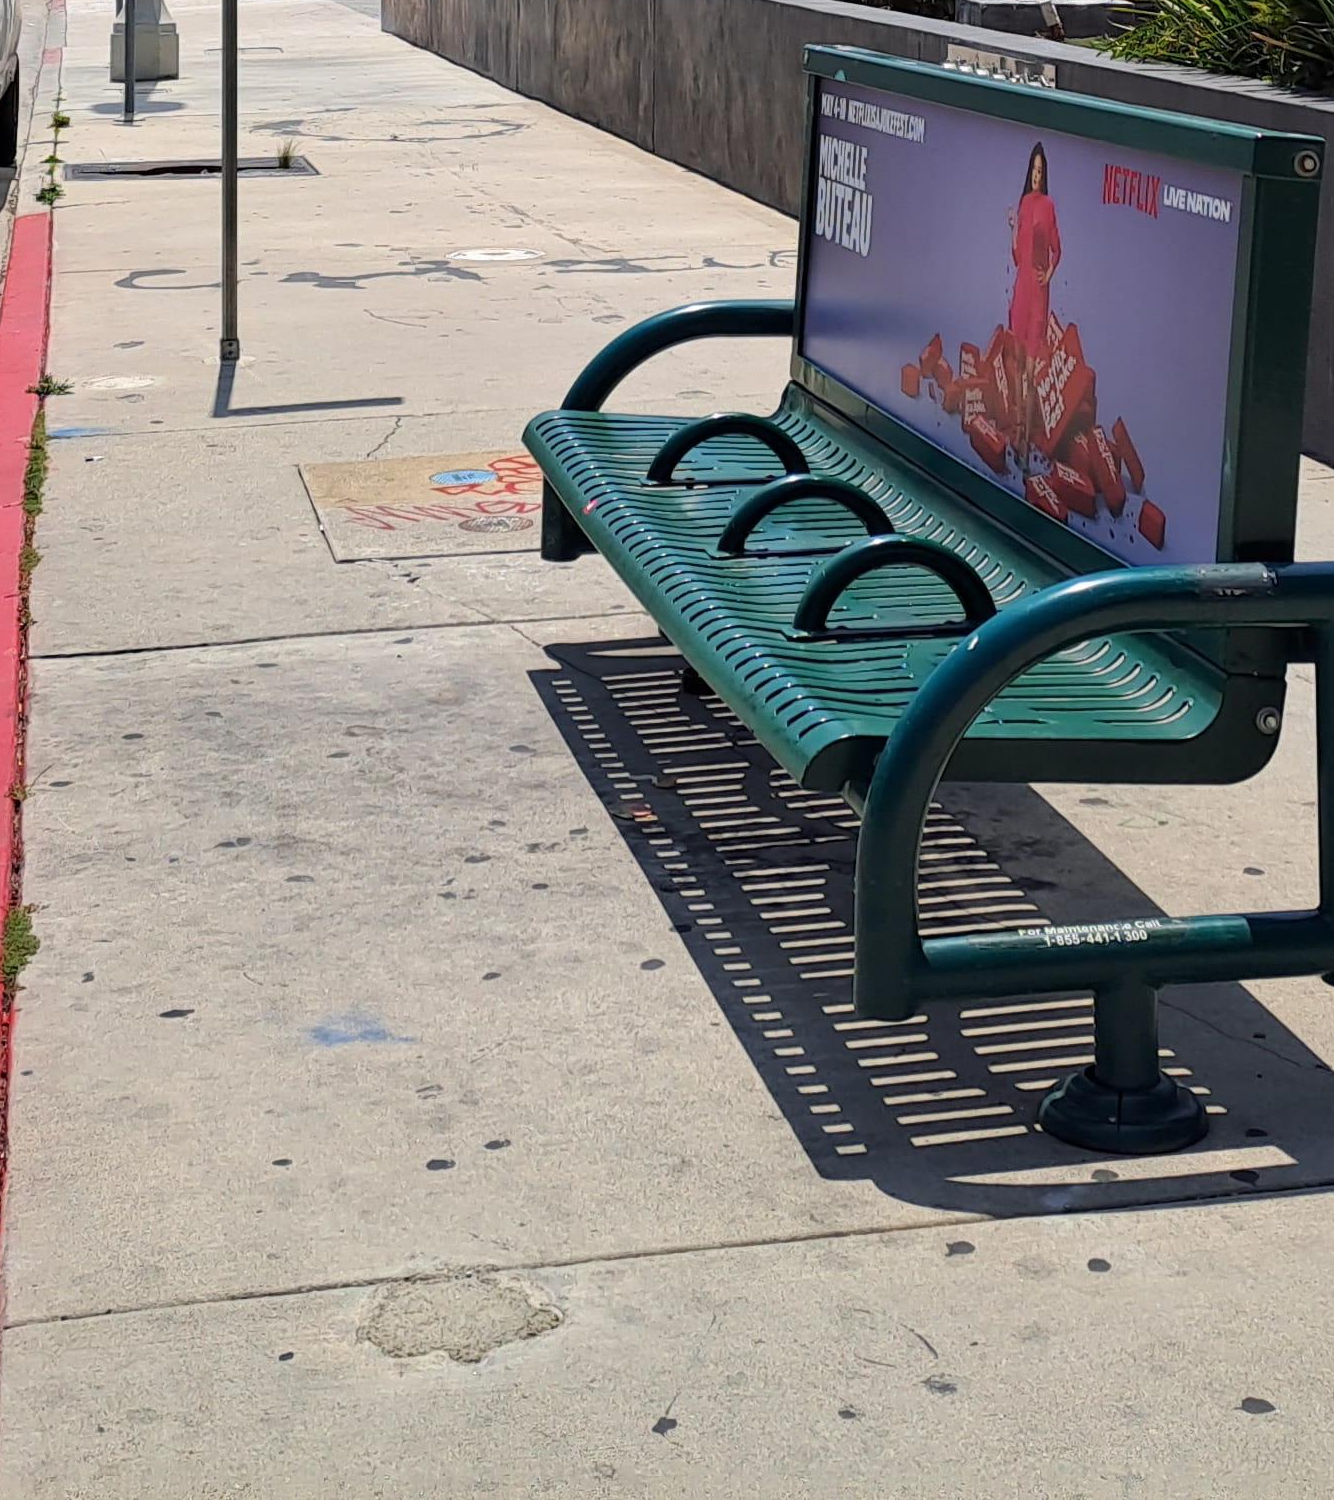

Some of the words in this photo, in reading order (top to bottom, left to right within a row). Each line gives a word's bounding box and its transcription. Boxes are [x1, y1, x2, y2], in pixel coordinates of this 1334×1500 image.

[821, 92, 834, 116] MAY
[818, 133, 868, 191] MICHELLE
[815, 176, 873, 258] BUTEAU
[1102, 163, 1161, 220] NETFLIX
[1163, 184, 1187, 211] LIVE
[1186, 190, 1231, 223] NATION
[1044, 922, 1132, 936] Maintenance
[1135, 918, 1163, 929] Call
